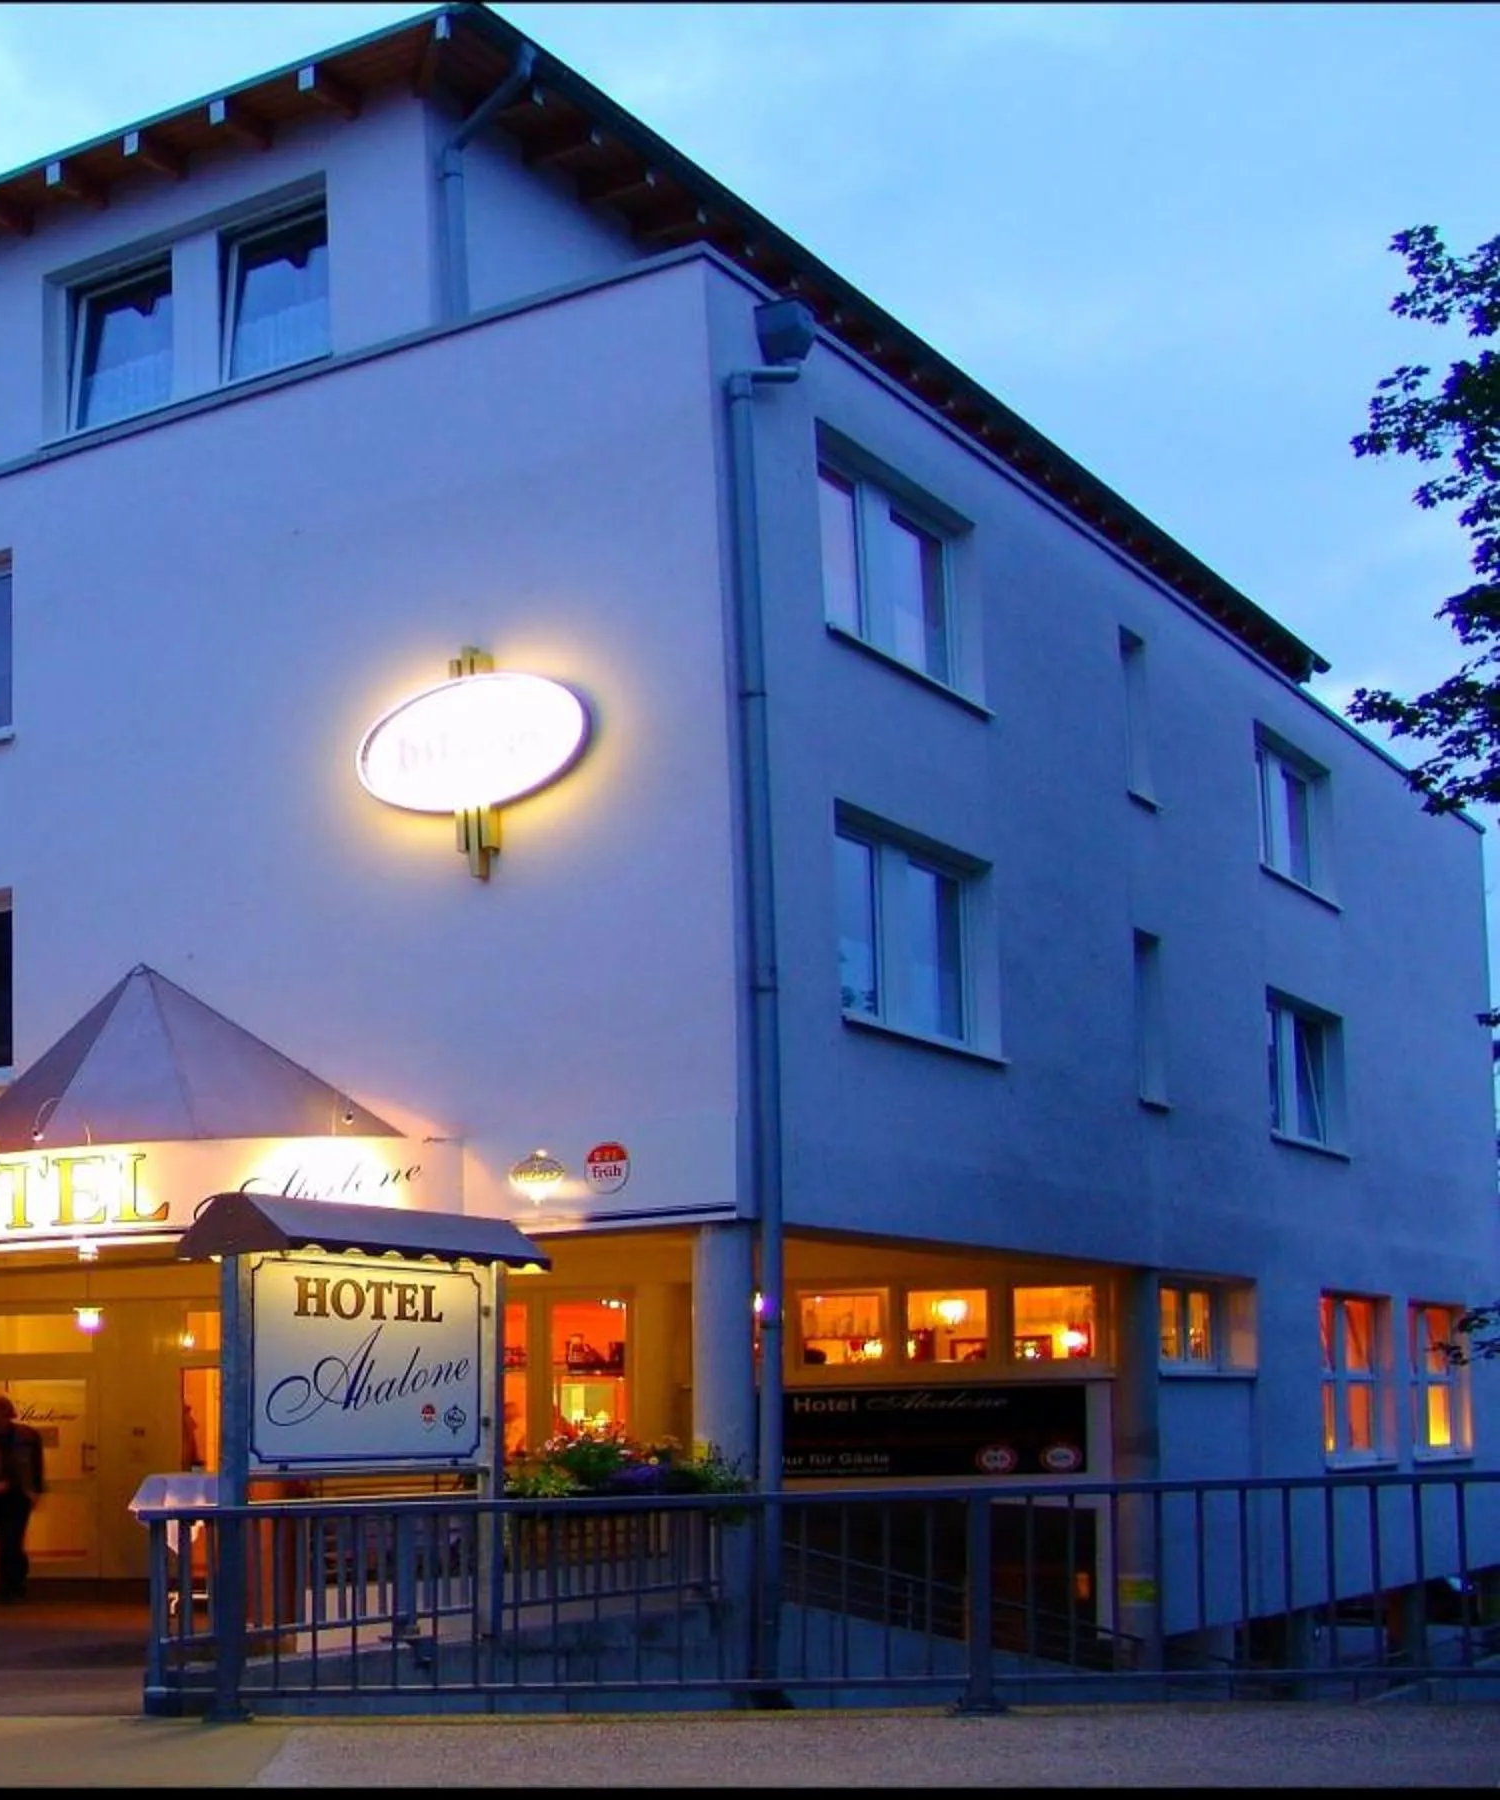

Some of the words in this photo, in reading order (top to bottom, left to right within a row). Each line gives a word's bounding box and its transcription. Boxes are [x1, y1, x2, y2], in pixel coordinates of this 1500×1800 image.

[294, 1275, 443, 1323] HOTEL
[265, 1323, 470, 1427] Abalone
[792, 1395, 858, 1414] Hotel
